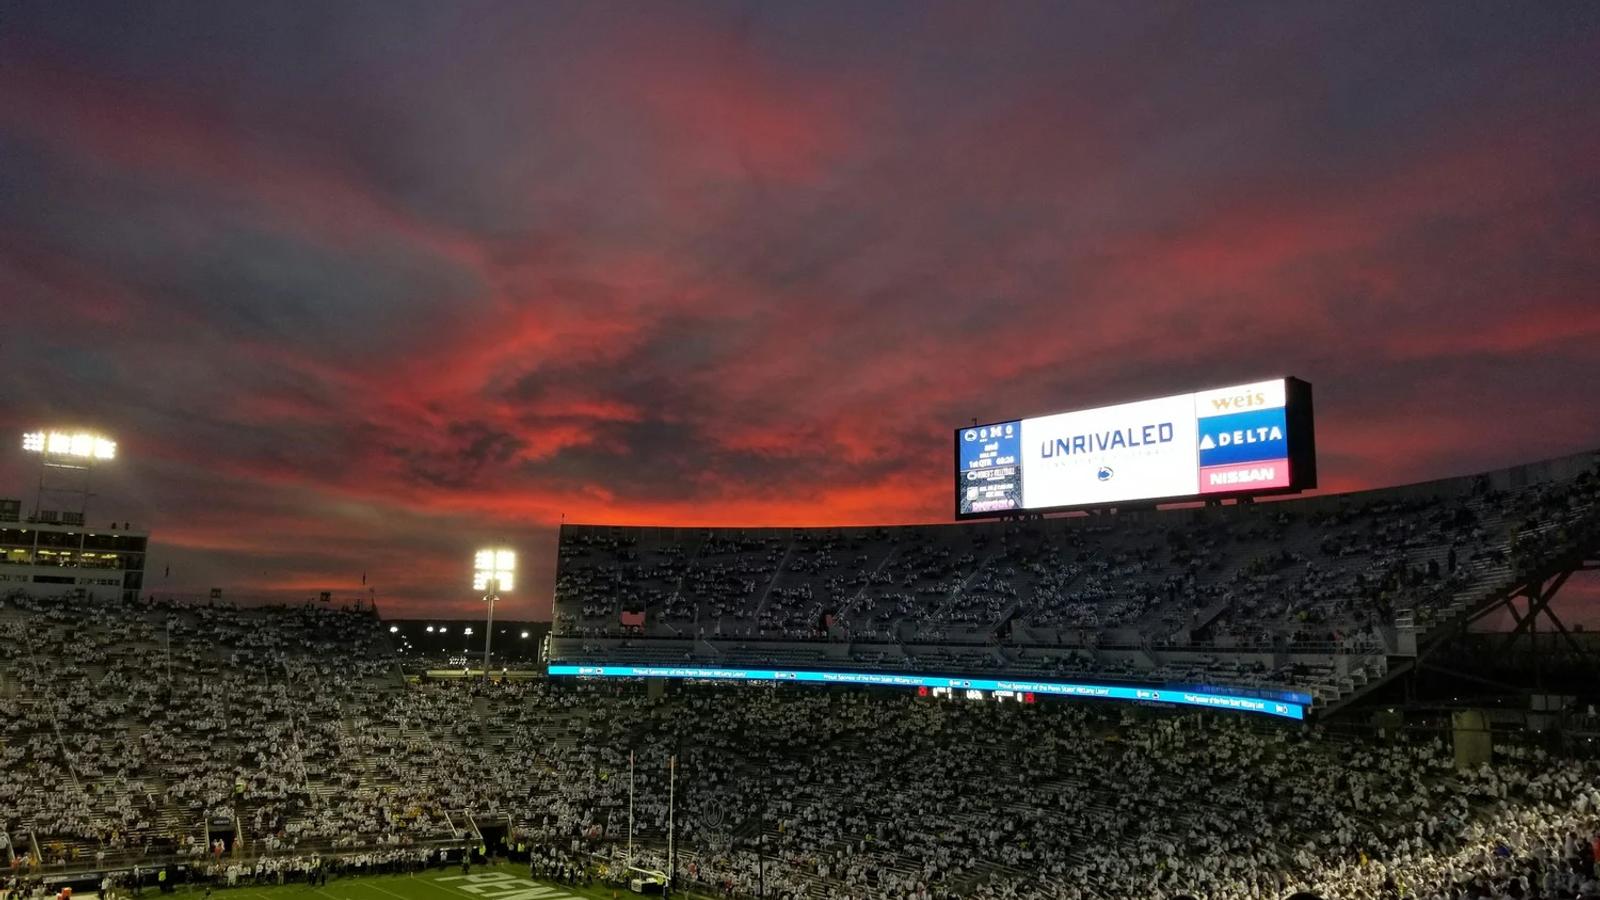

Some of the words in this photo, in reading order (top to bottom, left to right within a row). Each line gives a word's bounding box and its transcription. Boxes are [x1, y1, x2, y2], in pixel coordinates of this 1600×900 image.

[1211, 390, 1265, 410] weis
[1041, 422, 1173, 458] UNRIVALED
[1218, 426, 1282, 447] DELTA
[1210, 467, 1275, 485] NISSAN
[997, 682, 1011, 690] Proud
[1012, 682, 1032, 691] Sponsor
[1048, 684, 1060, 692] Penn
[434, 872, 589, 900] PEN
